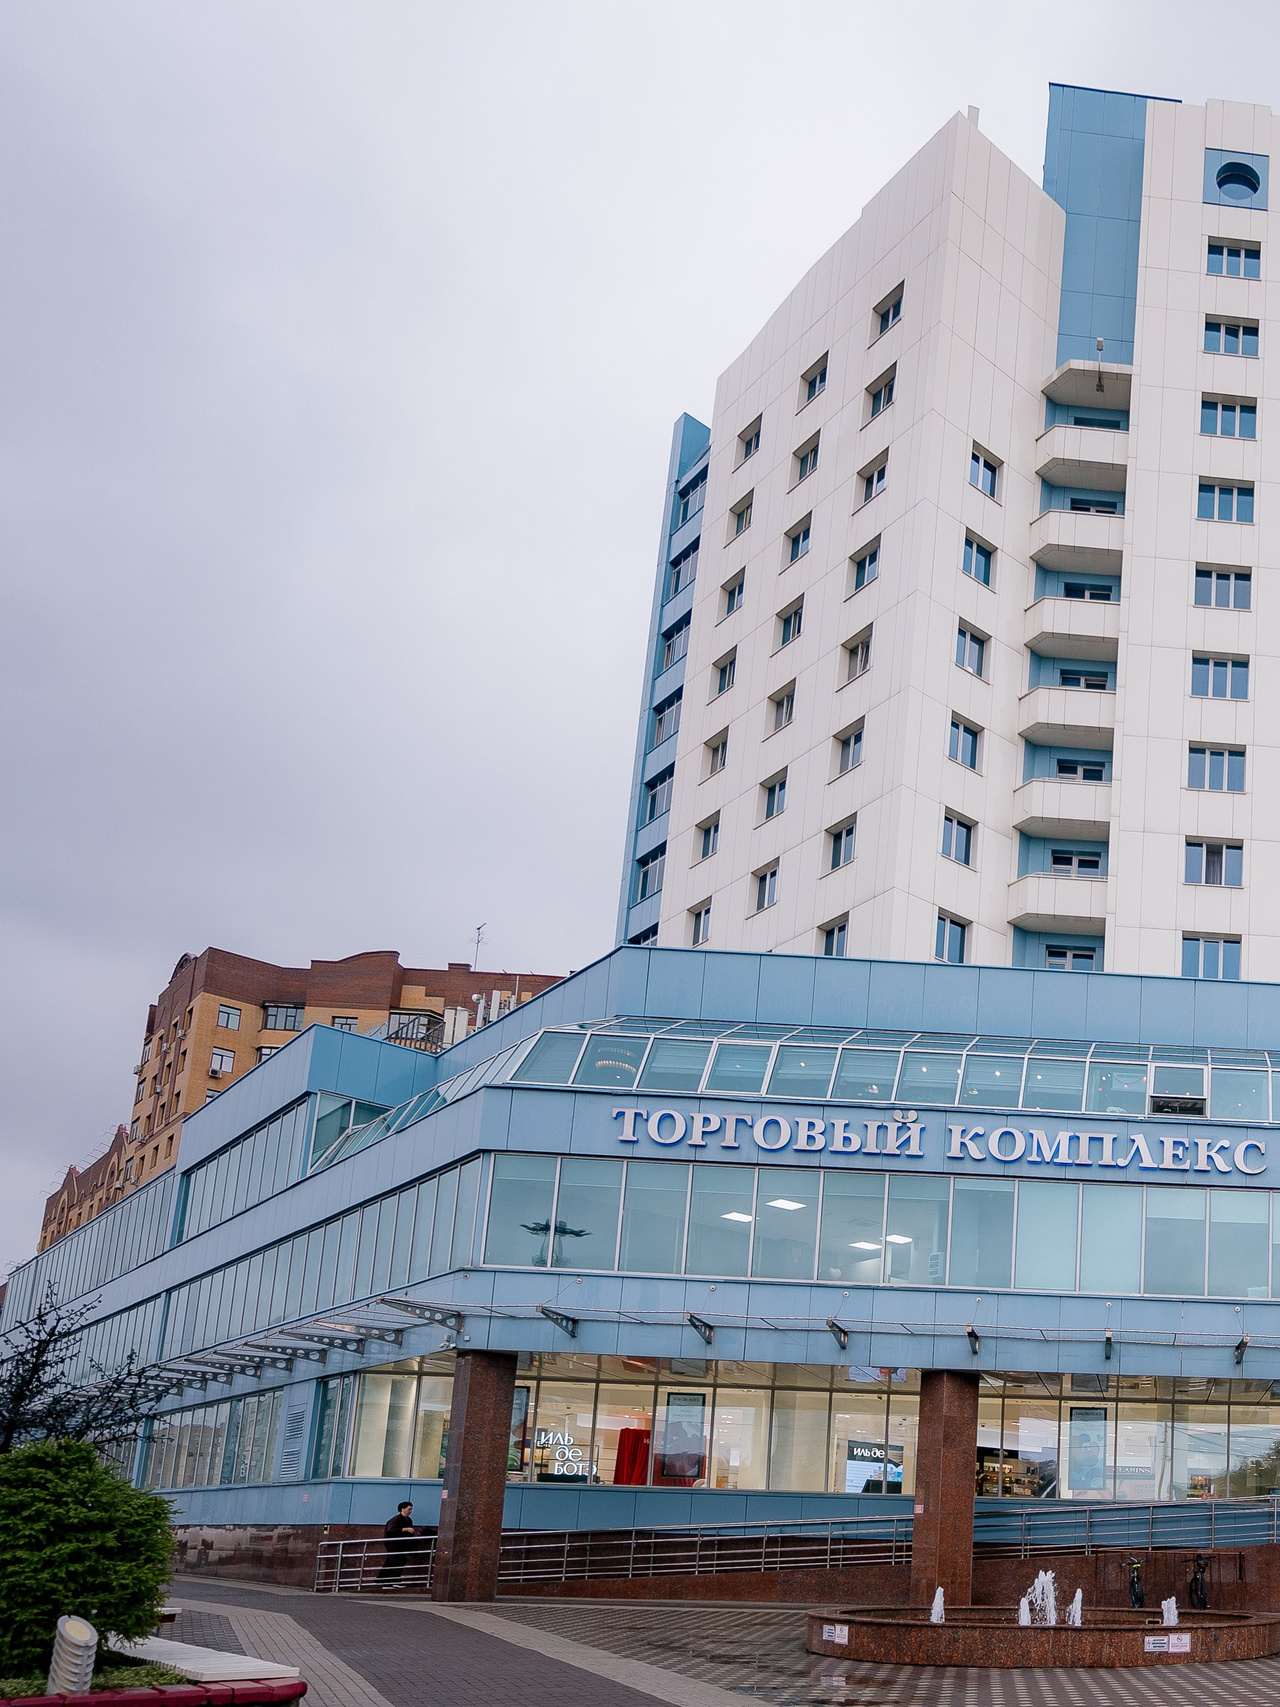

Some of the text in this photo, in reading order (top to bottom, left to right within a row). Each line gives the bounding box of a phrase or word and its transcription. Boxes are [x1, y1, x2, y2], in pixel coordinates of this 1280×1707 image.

[612, 1108, 1268, 1176] ТОРГОВЫЙ КОМПЛЕКС
[540, 1431, 574, 1446] ИЛЬ
[853, 1447, 870, 1457] ИЛЬ
